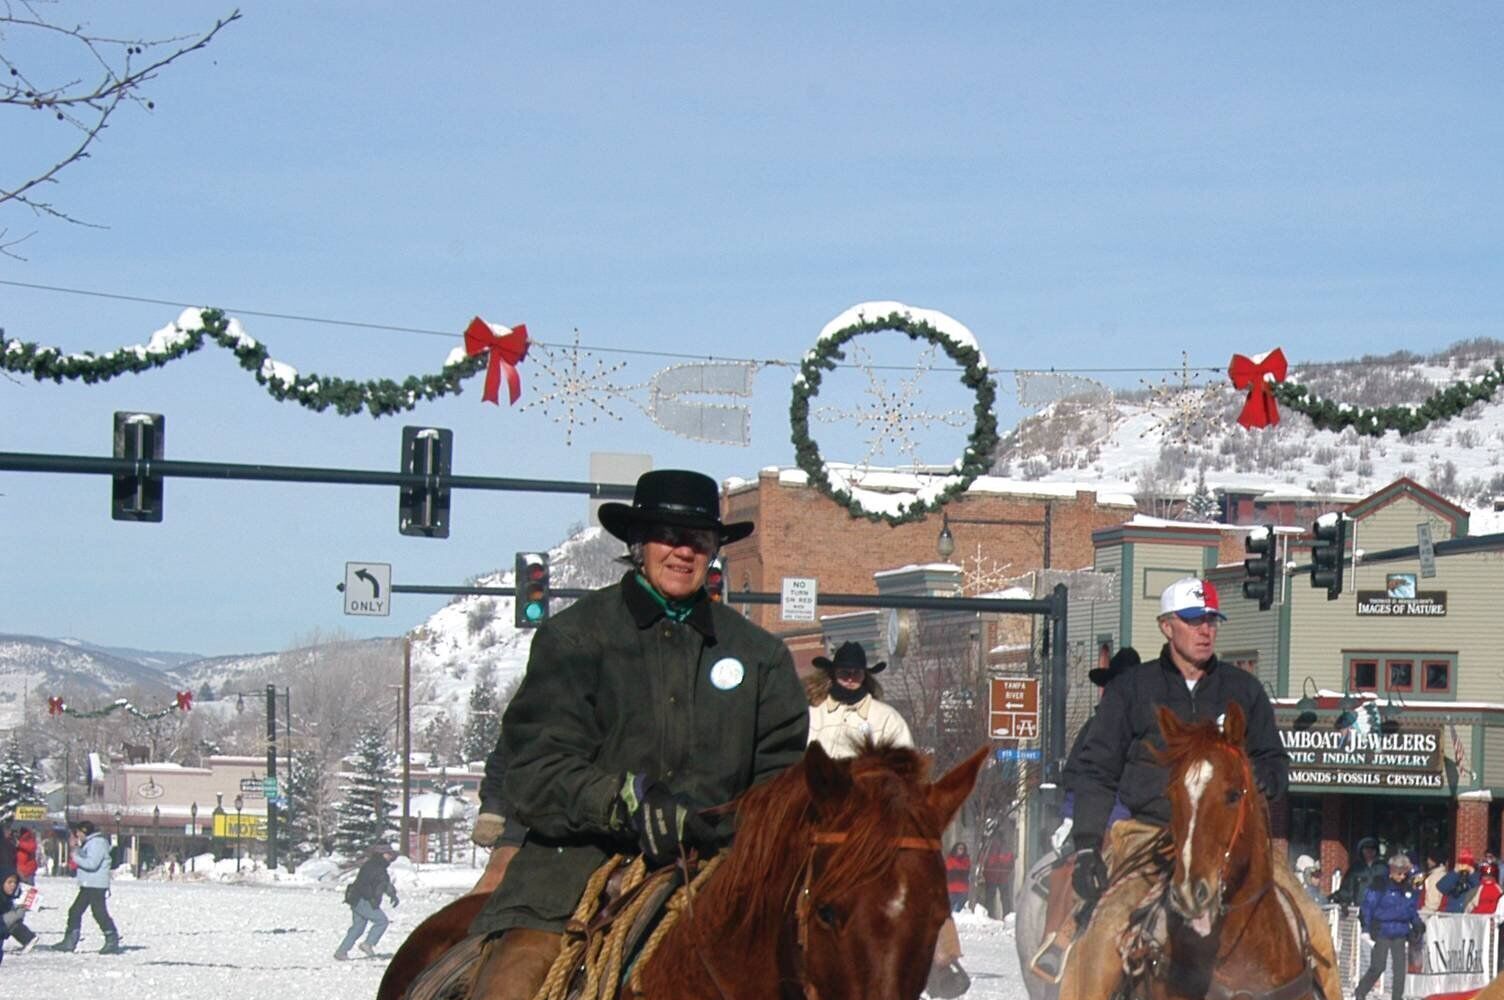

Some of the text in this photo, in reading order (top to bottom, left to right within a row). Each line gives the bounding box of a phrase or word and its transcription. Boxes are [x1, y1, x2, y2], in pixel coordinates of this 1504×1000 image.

[792, 580, 806, 589] NO
[350, 600, 384, 612] ONLY
[1005, 691, 1024, 699] RIVER
[1345, 729, 1437, 753] JEWELERS
[1323, 752, 1366, 764] INDIAN
[1372, 754, 1431, 767] JEWELRY
[1337, 771, 1381, 785] FOSSILS
[1387, 773, 1442, 787] CRYSTALS
